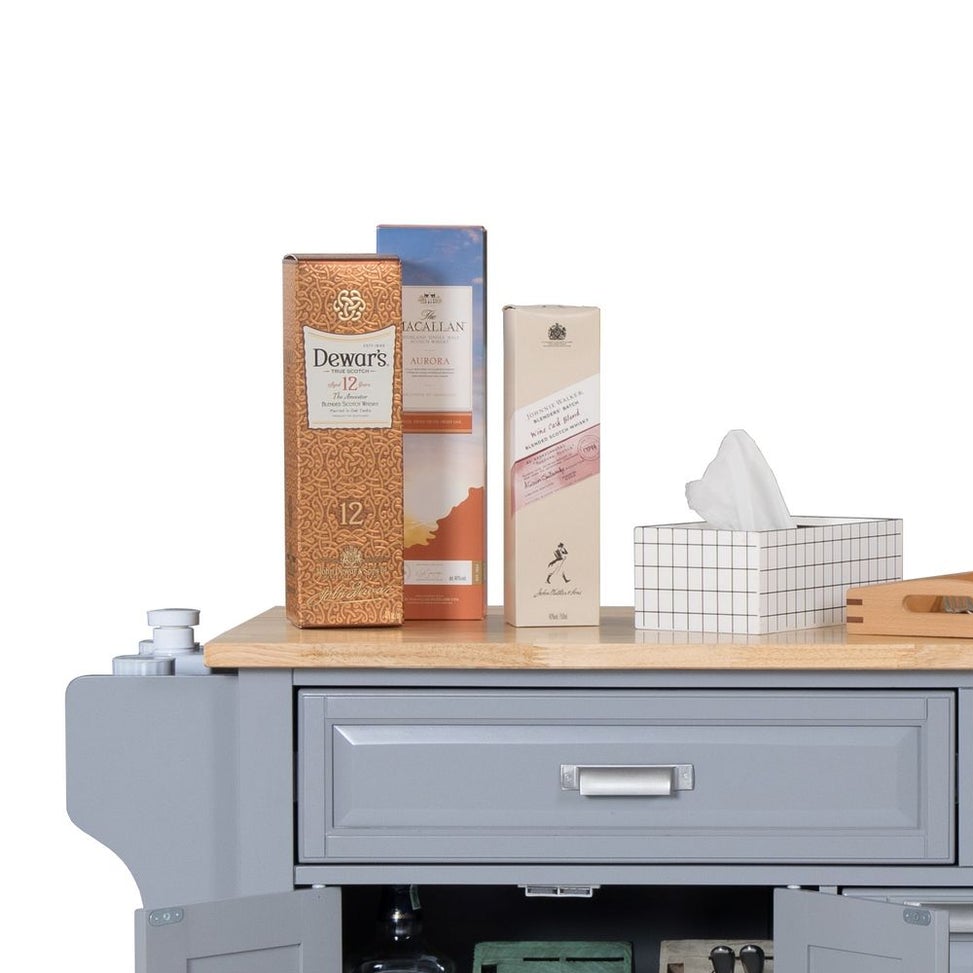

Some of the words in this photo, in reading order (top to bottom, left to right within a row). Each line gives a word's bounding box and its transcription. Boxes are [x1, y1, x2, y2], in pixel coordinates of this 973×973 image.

[419, 309, 437, 321] The
[313, 348, 387, 368] Dewar's
[410, 357, 450, 365] AURORA
[342, 376, 358, 391] 12
[526, 403, 555, 420] JOHNNIE
[556, 391, 583, 406] WALKER
[549, 427, 569, 439] SCOTCH
[339, 501, 364, 526] 12
